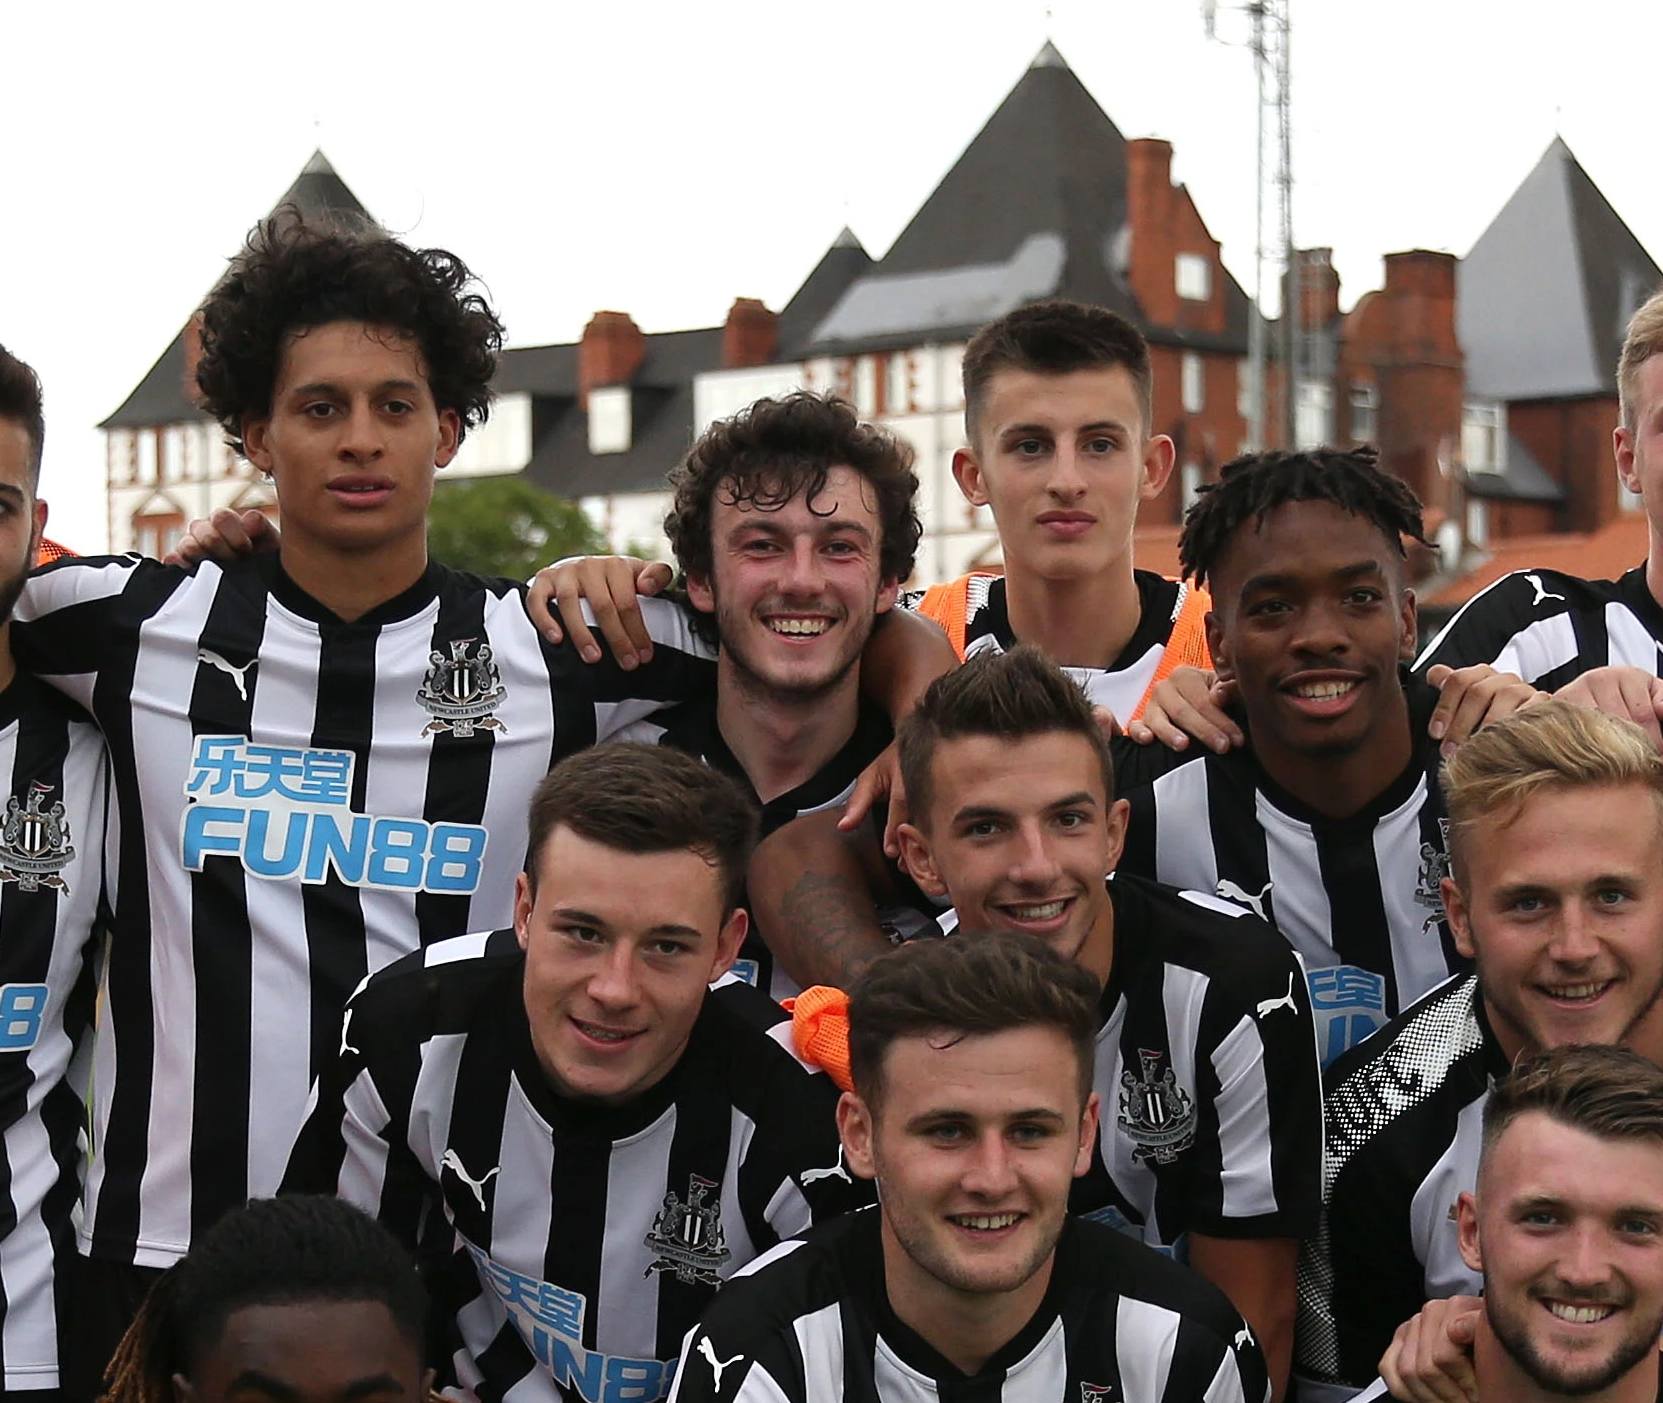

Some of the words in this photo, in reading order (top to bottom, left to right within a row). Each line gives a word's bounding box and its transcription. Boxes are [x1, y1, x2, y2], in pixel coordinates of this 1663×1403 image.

[428, 703, 468, 715] NEWCASTLE
[470, 701, 496, 714] UNITED
[187, 737, 351, 805] 乐天堂
[38, 860, 63, 869] UNITED
[183, 806, 487, 891] FUN88
